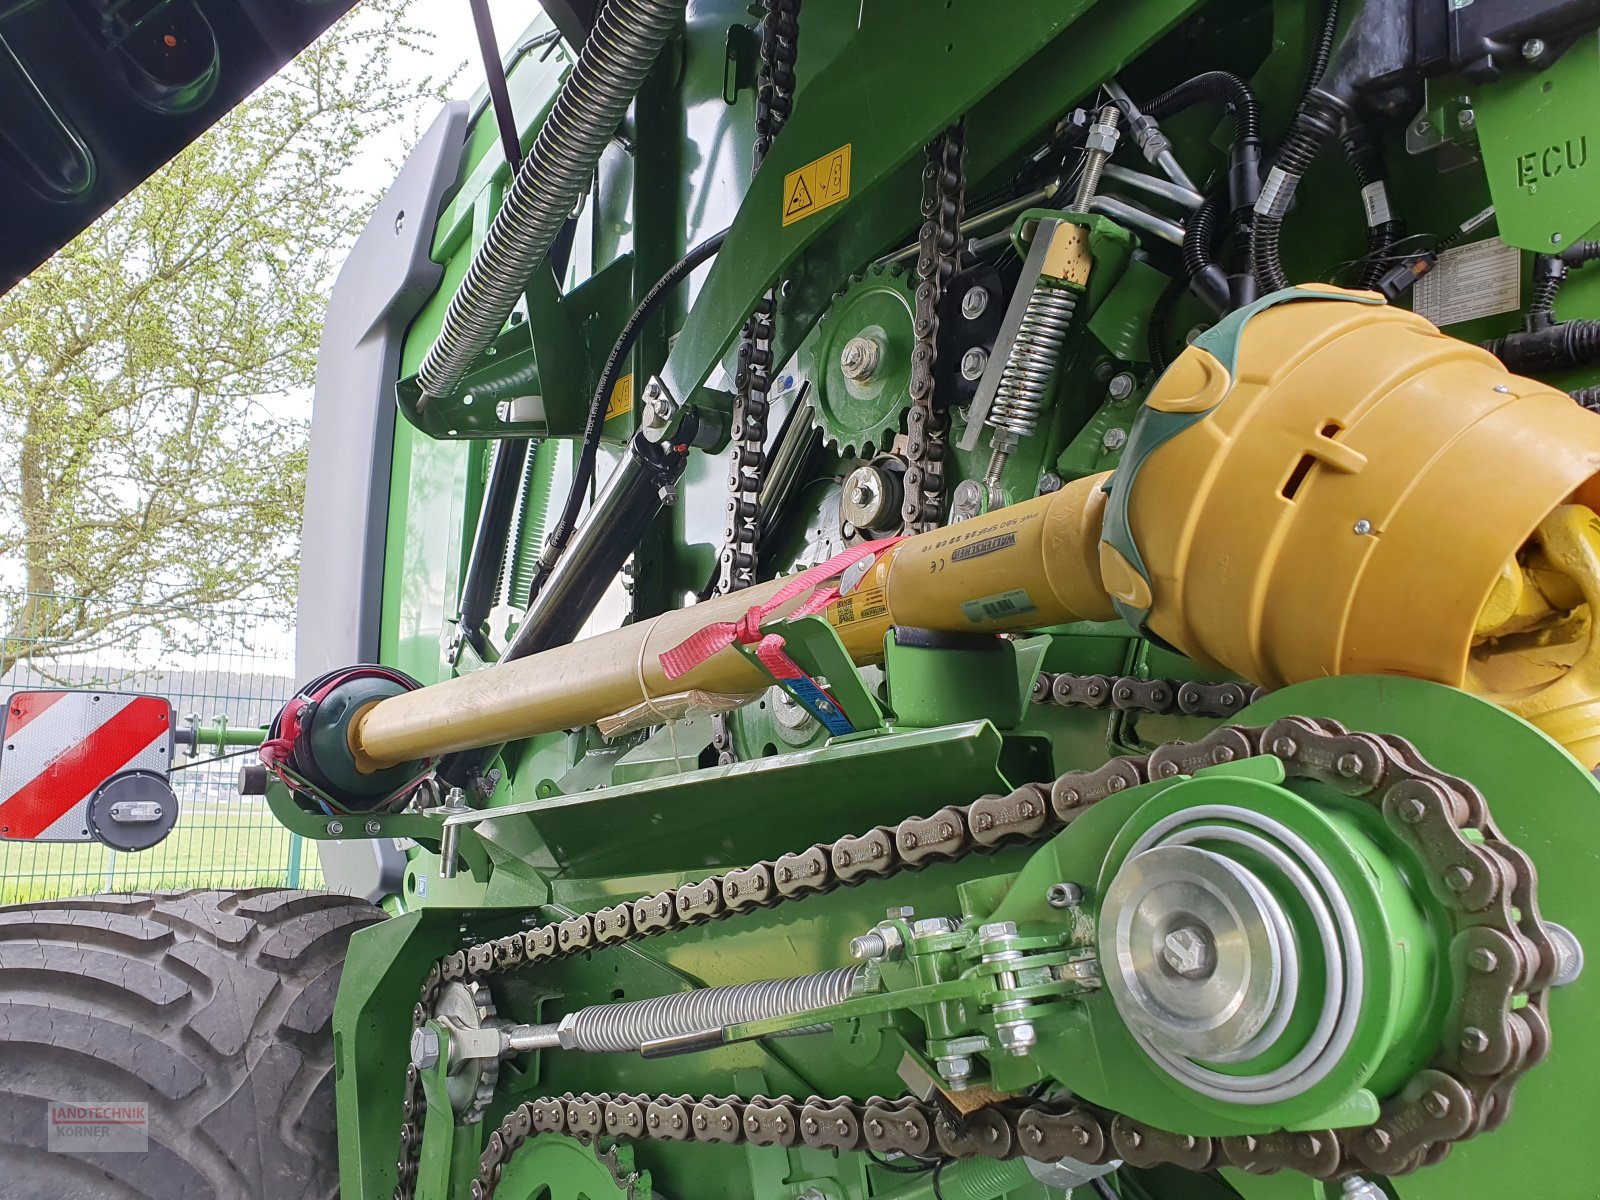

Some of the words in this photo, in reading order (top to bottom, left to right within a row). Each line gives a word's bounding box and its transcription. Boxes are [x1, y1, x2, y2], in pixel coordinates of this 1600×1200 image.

[1517, 136, 1587, 187] ECU
[639, 302, 647, 311] EN
[605, 361, 613, 375] BAR
[951, 533, 1016, 561] WALTERSCHEID
